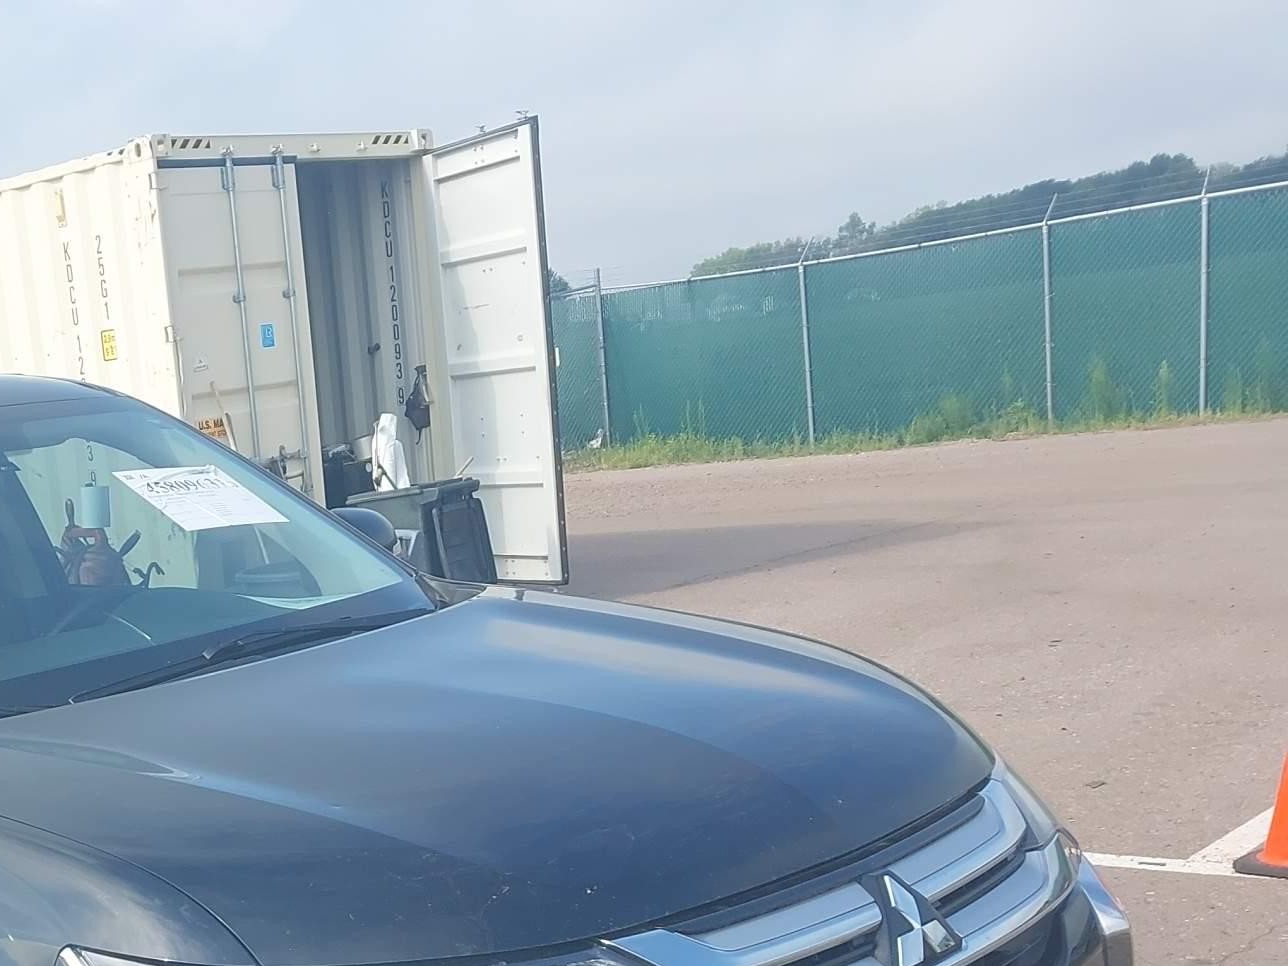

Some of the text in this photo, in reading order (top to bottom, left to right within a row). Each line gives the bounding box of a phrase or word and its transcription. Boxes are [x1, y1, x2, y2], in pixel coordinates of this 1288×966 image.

[381, 180, 393, 257] KDCU
[62, 241, 79, 327] KDCU
[95, 234, 110, 321] 25G1
